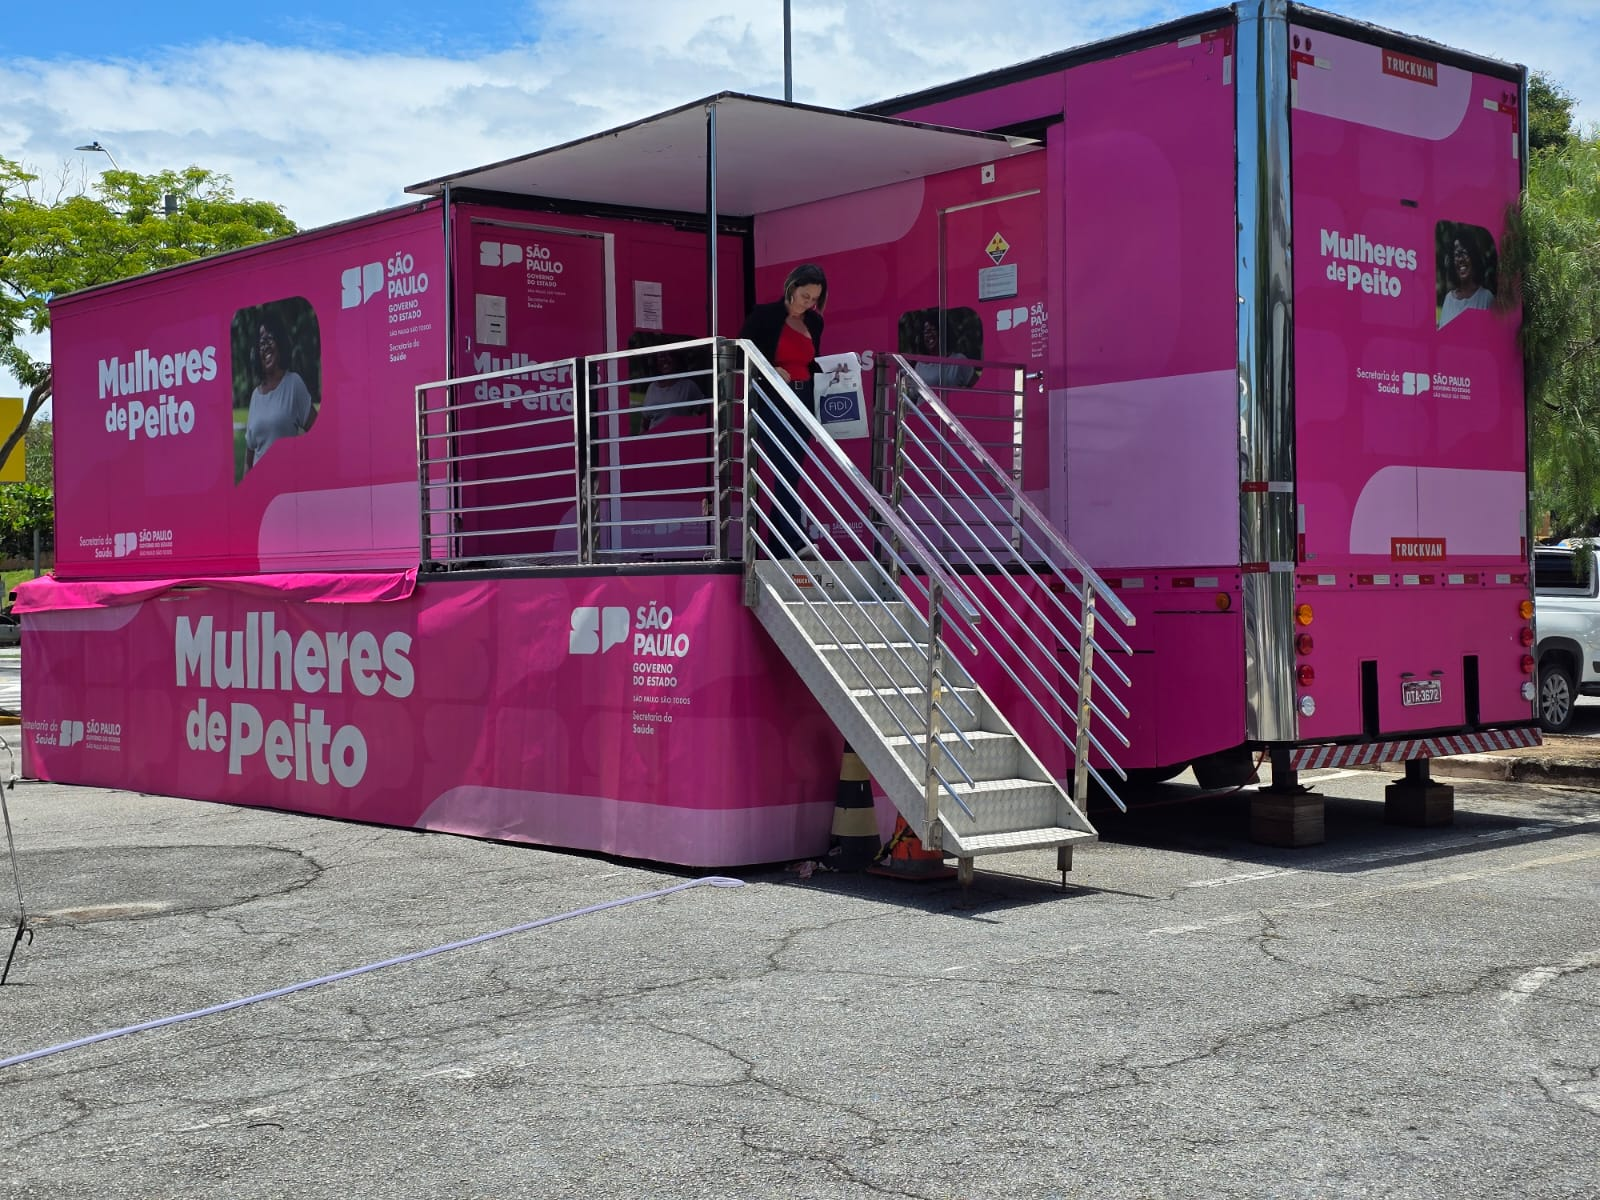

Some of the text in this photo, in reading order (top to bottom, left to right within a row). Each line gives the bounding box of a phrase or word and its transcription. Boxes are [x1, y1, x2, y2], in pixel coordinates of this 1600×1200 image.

[1387, 55, 1434, 81] TRUCKVAN
[526, 243, 550, 259] SÃO
[1320, 228, 1417, 271] Mulheres
[387, 251, 414, 277] SÃO
[526, 259, 563, 273] PAULO
[388, 272, 428, 299] PAULO
[1347, 264, 1401, 297] Peito
[388, 299, 418, 313] GOVERNO
[389, 309, 422, 323] DO ESTADO
[98, 345, 218, 399] Mulheres
[1356, 368, 1389, 381] Secretaria
[1433, 373, 1471, 388] SÃO PAULO
[105, 394, 195, 440] de Peito
[139, 529, 172, 542] SÃO PAULO
[1395, 543, 1442, 557] TRUCKVAN
[635, 600, 673, 630] SÃO
[633, 633, 689, 658] PAULO
[175, 611, 415, 698] Mulheres
[633, 662, 673, 674] GOVERNO
[633, 676, 678, 687] DO ESTADO
[633, 710, 662, 722] Secretaria
[86, 718, 121, 735] SÃO PAULO
[633, 723, 654, 735] Saúde
[186, 698, 368, 788] de Peito
